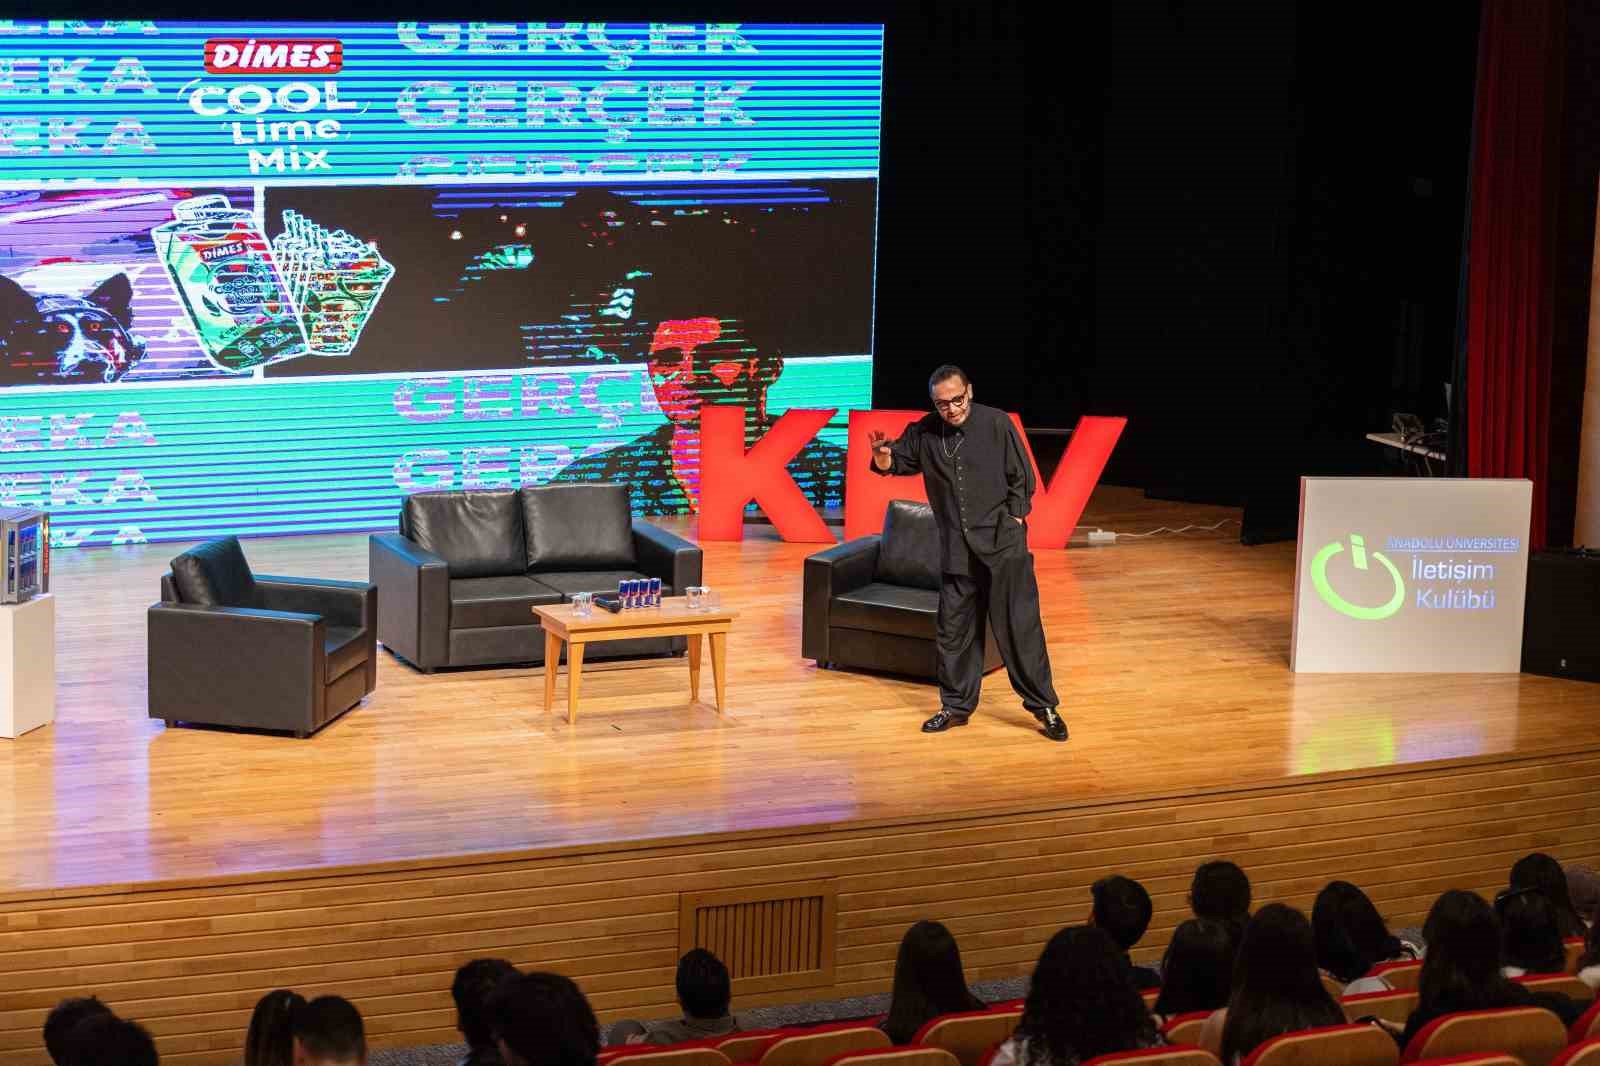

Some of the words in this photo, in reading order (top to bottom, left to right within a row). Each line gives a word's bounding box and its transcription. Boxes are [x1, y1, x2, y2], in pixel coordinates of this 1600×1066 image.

[188, 81, 358, 117] COOL
[395, 80, 757, 145] GERÇEK
[231, 117, 341, 145] Lime
[248, 145, 333, 175] Mix
